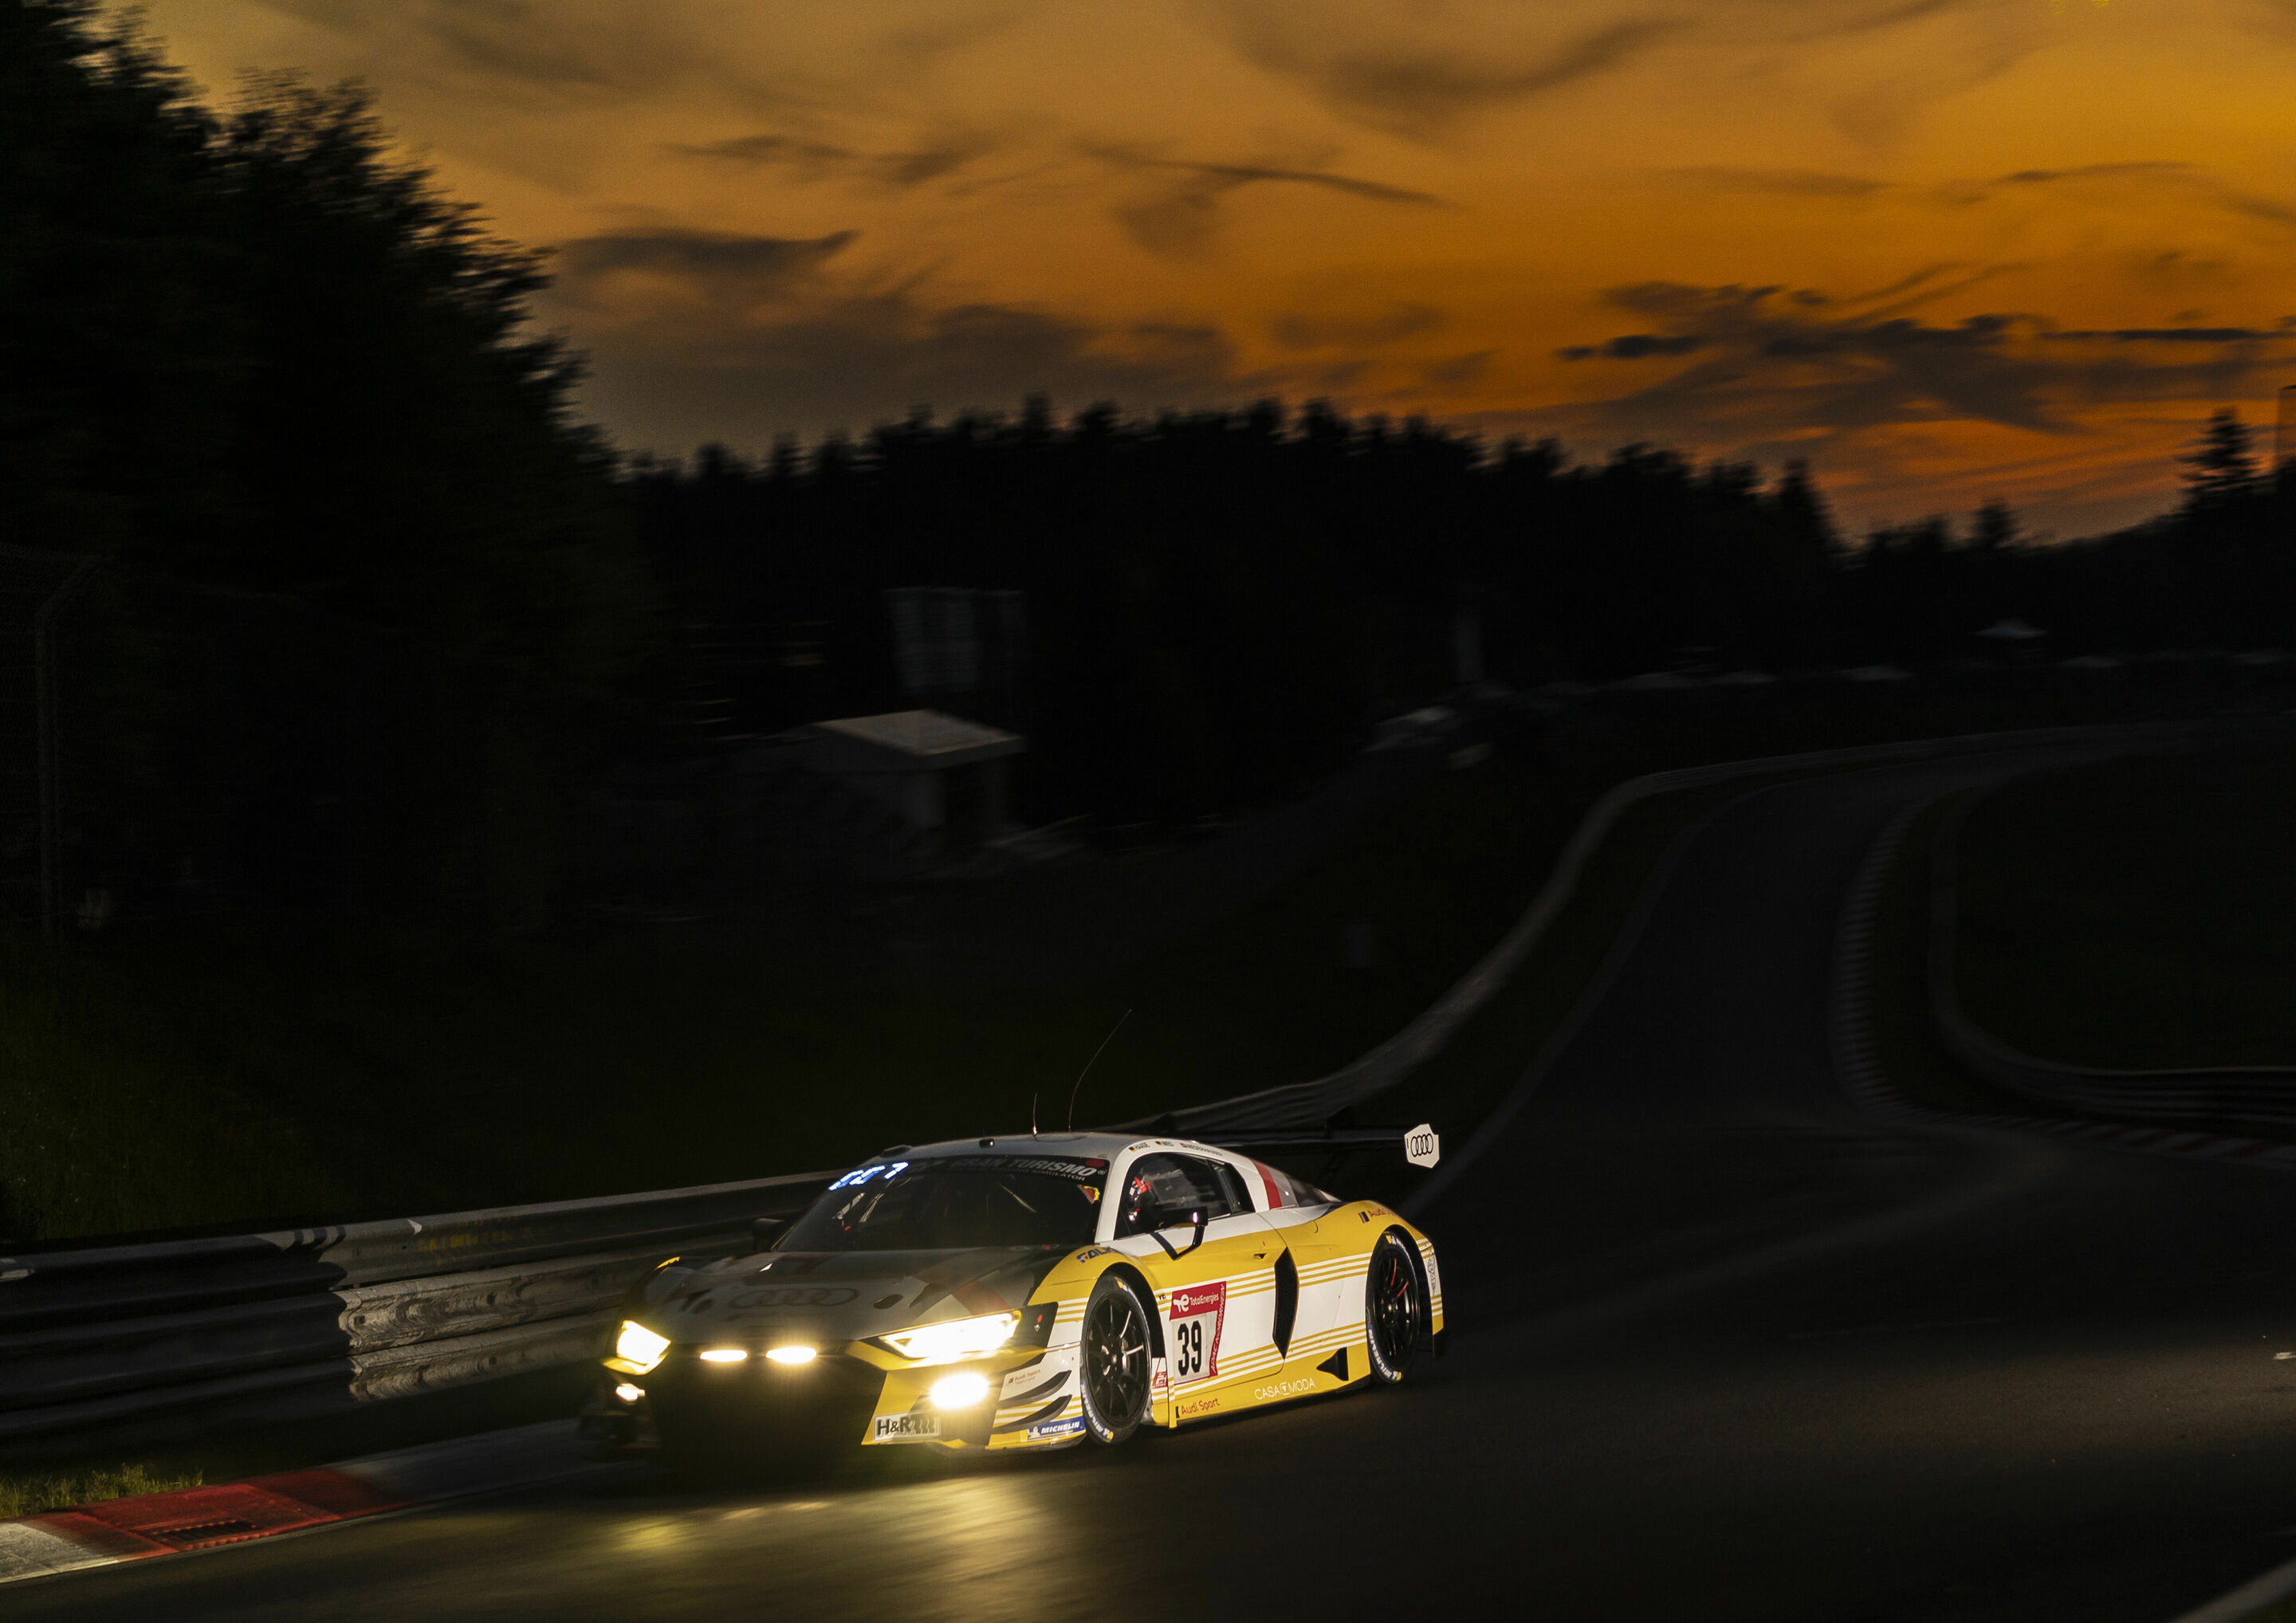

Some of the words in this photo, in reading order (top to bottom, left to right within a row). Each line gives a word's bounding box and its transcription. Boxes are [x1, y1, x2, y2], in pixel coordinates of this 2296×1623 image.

[1008, 1159, 1097, 1177] TURISMO
[1189, 1293, 1219, 1306] TotalEnergies
[1177, 1320, 1201, 1376] 39
[1181, 1402, 1197, 1415] Audi
[1198, 1397, 1220, 1412] Sport
[877, 1417, 911, 1436] H&R
[1041, 1421, 1080, 1434] MICHELIN
